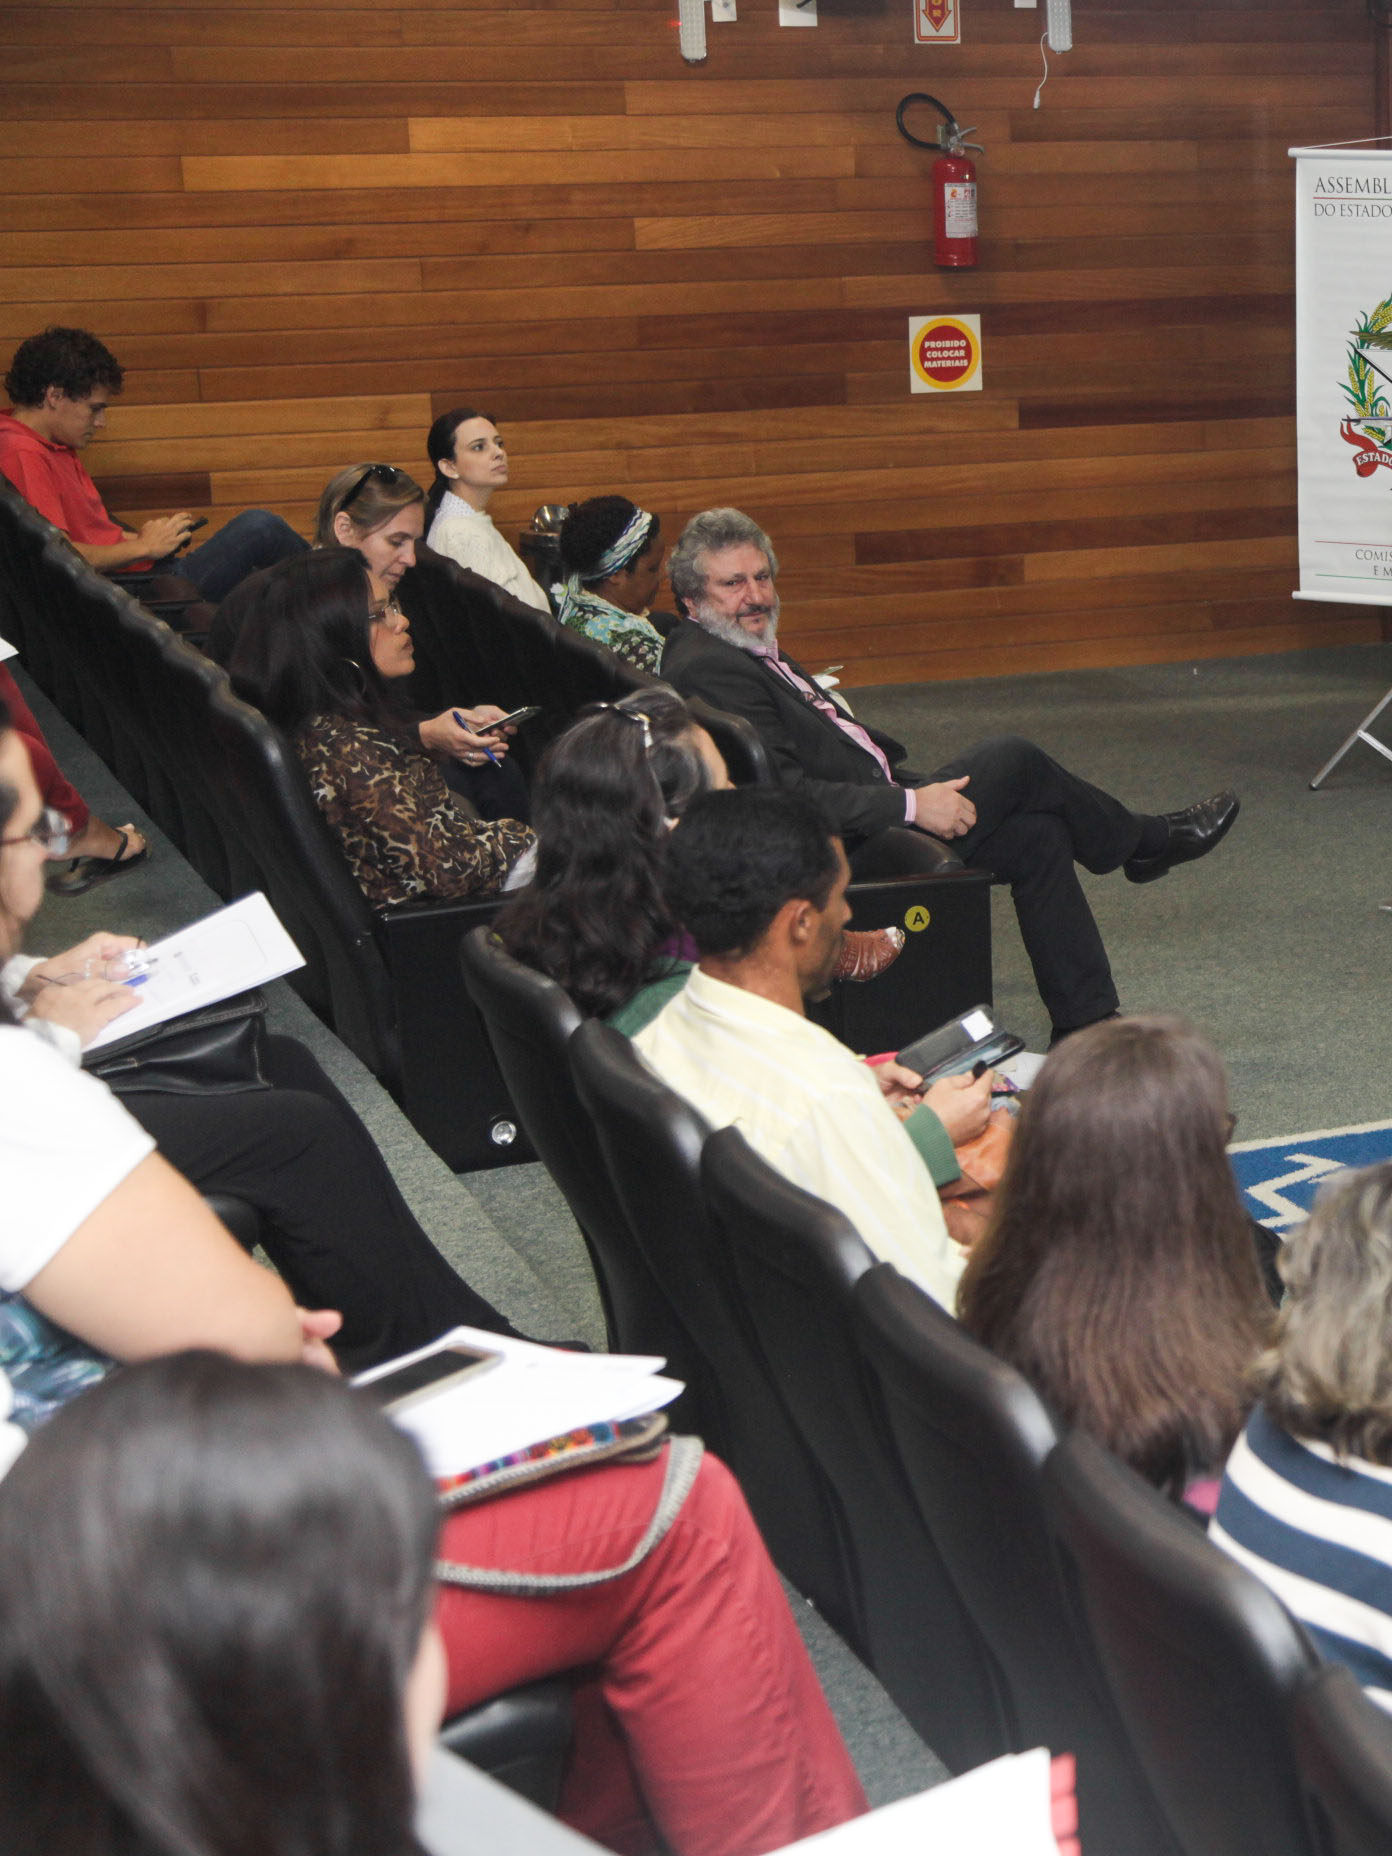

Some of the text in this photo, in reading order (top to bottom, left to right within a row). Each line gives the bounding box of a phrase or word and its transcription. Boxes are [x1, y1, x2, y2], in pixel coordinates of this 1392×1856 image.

[1314, 203, 1336, 217] DO
[1340, 203, 1392, 218] ESTADO
[924, 340, 966, 349] PROIBIDO
[926, 350, 965, 358] COLOCAR
[924, 359, 968, 368] MATERIAIS
[1374, 565, 1378, 576] E
[912, 912, 925, 926] A
